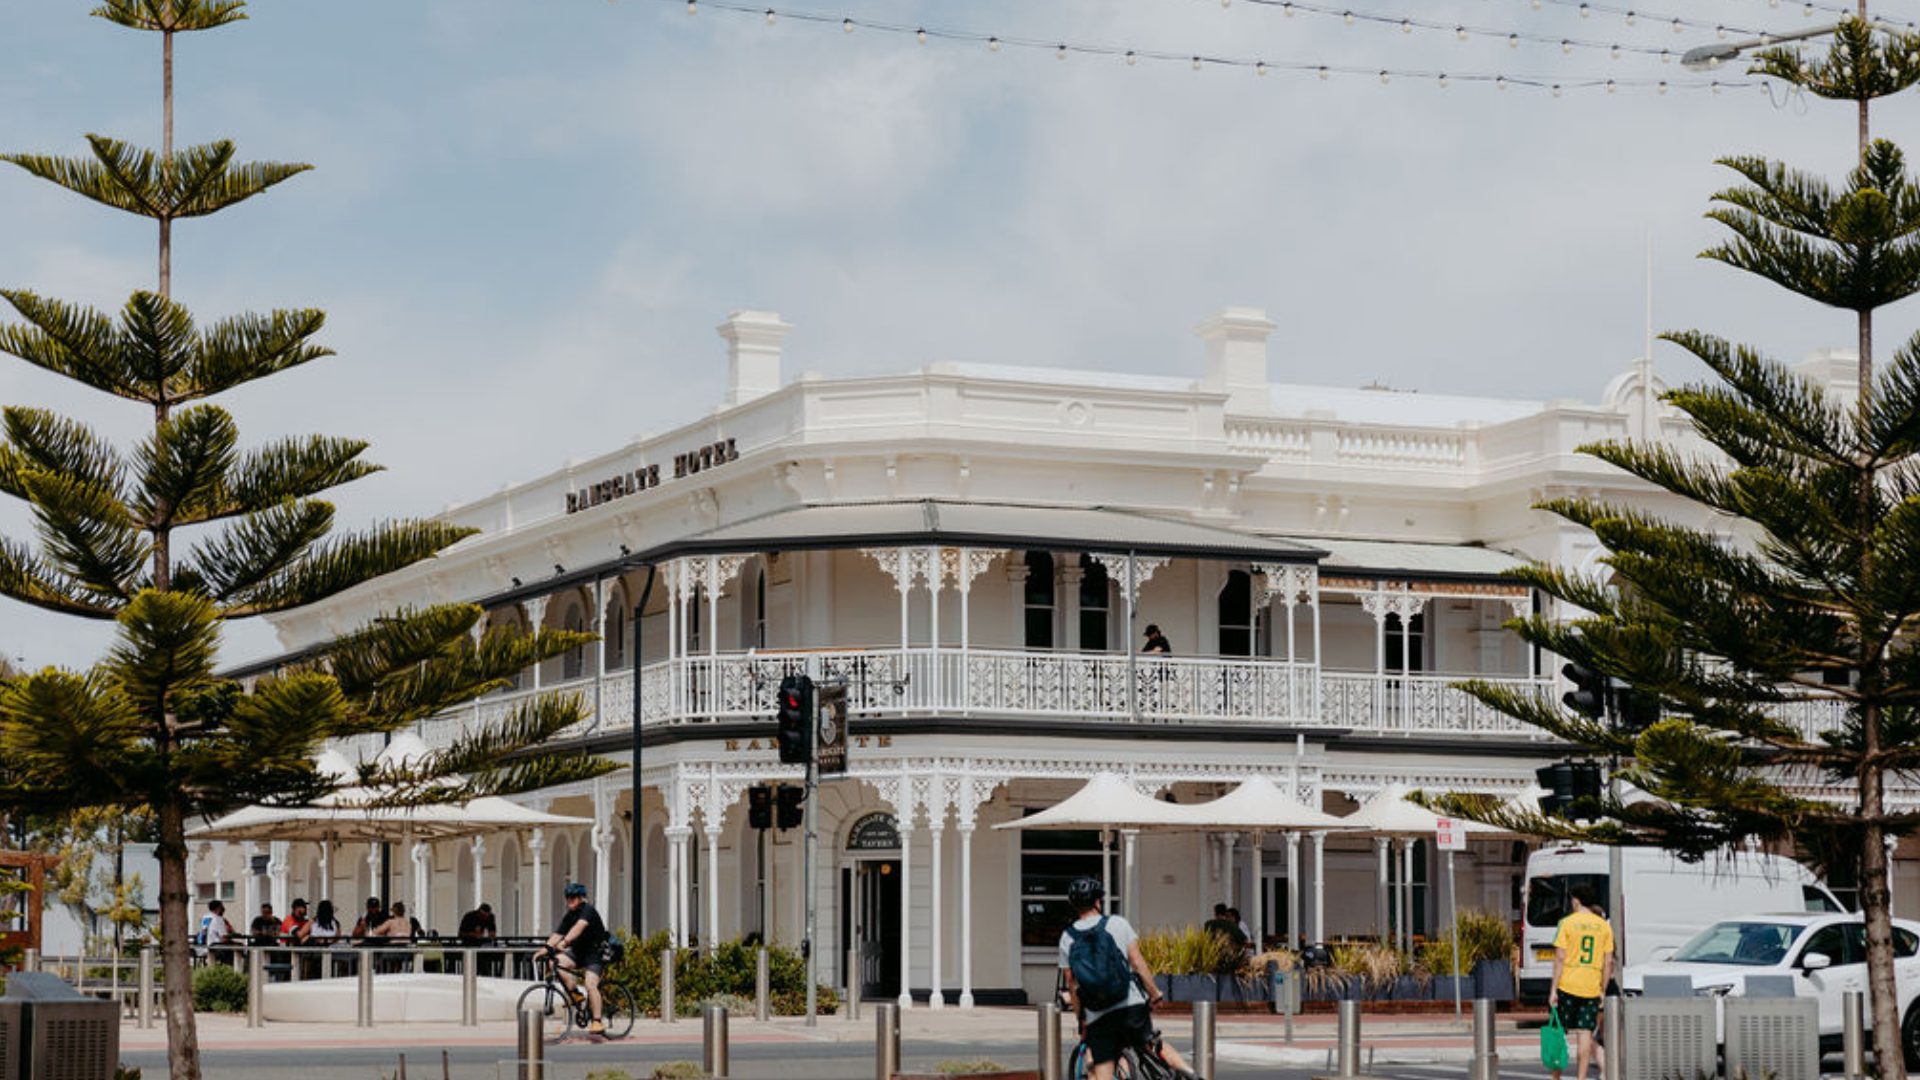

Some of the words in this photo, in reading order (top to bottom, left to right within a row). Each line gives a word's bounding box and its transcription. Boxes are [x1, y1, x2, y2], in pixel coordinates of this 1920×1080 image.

[566, 464, 660, 515] RAMSGATE
[673, 438, 739, 479] HOTEL
[725, 735, 893, 752] RAMTE
[1580, 935, 1594, 964] 9
